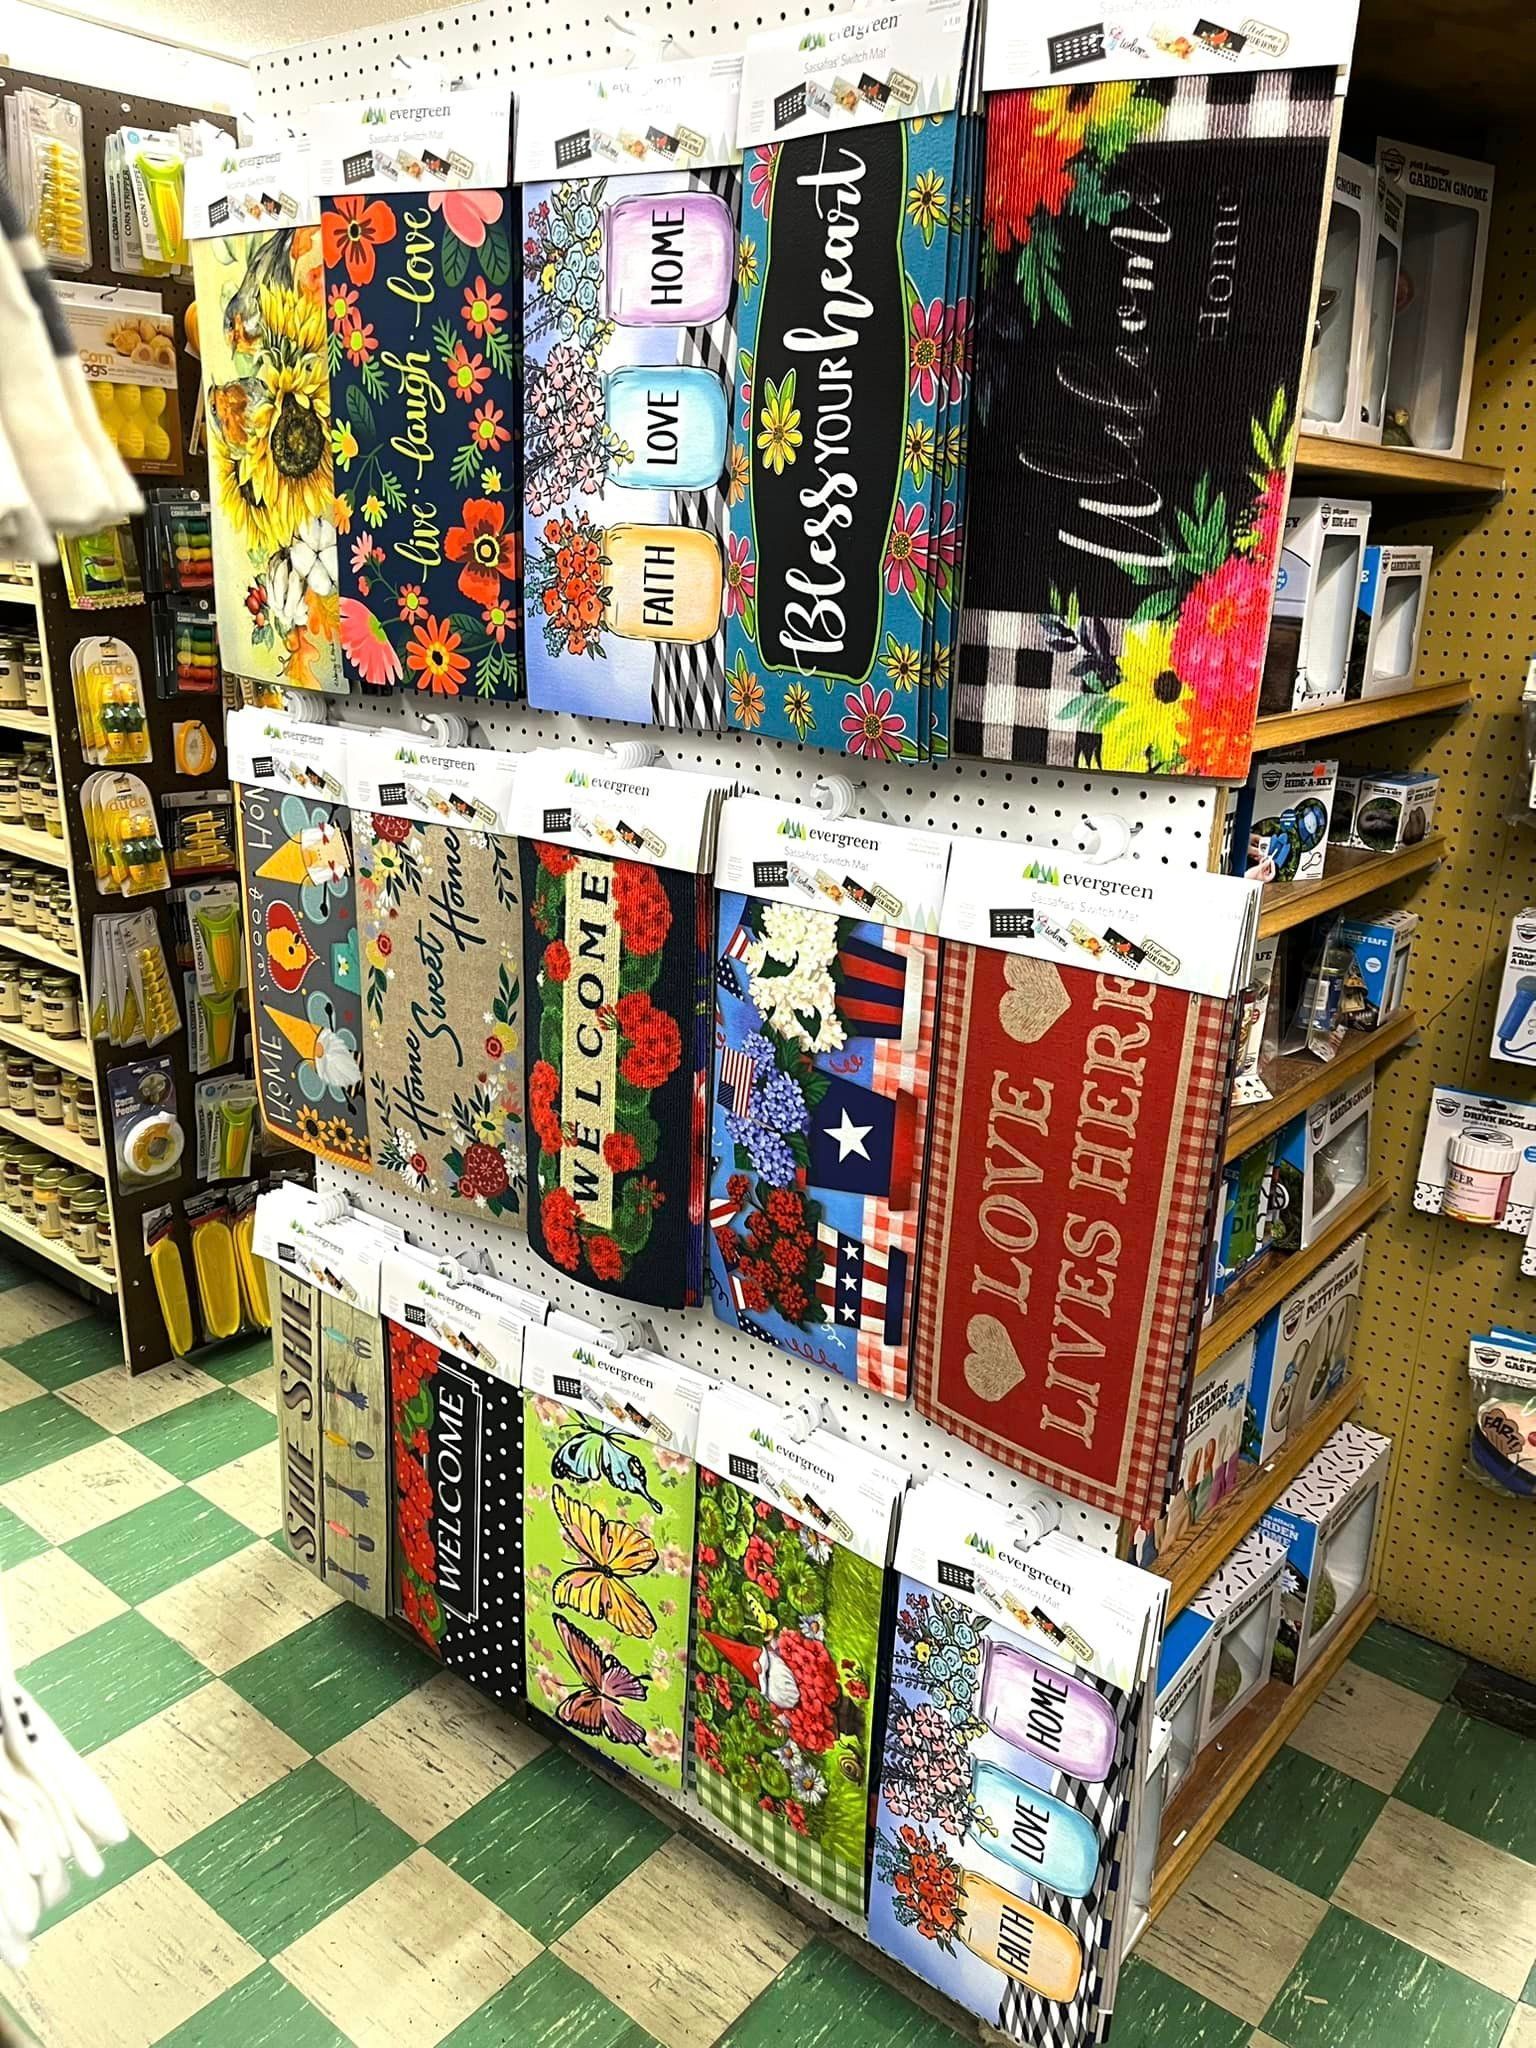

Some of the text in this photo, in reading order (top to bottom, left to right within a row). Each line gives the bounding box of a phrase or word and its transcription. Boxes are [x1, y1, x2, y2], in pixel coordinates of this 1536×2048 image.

[868, 46, 887, 60] Mat
[389, 105, 451, 122] evergreen
[239, 151, 281, 170] evergreen
[1335, 175, 1362, 200] GNOME
[1409, 171, 1488, 202] GARDEN GNOME
[650, 206, 686, 306] HOME
[79, 348, 115, 365] Corn
[82, 363, 108, 377] ogs
[381, 207, 447, 584] live laugh love
[779, 132, 874, 678] Bless YOUR heart
[646, 388, 680, 465] LOVE
[642, 544, 676, 627] FAITH
[89, 661, 135, 676] dude
[282, 731, 324, 746] evergreen
[419, 754, 475, 772] evergreen
[591, 777, 650, 797] evergreen
[1284, 777, 1334, 789] HIDE-A-KEY
[107, 797, 148, 813] dude
[809, 828, 879, 851] evergreen
[429, 827, 487, 952] Home
[1062, 872, 1154, 900] evergreen
[244, 785, 293, 1123] HOME sweet HOM
[1255, 950, 1273, 962] AFE
[411, 919, 463, 1068] Sweet
[573, 871, 610, 1204] WELCOME
[392, 1028, 446, 1141] Home
[1463, 1110, 1497, 1125] DRINK
[1464, 1104, 1508, 1117] prescription
[972, 1069, 1055, 1316] LOVE
[1040, 972, 1157, 1450] LIVES HERE
[305, 1230, 344, 1256] evergreen
[437, 1291, 481, 1321] evergreen
[597, 1360, 654, 1389] evergreen
[1504, 1360, 1526, 1373] GAS
[1196, 1379, 1229, 1416] HANDS
[1185, 1392, 1229, 1438] LECTION
[1483, 1415, 1521, 1452] FART!
[776, 1443, 835, 1483] evergreen
[437, 1385, 465, 1593] WELCOME
[1260, 1518, 1299, 1542] ARDEN
[998, 1551, 1072, 1596] evergreen
[1026, 1668, 1070, 1754] HOME
[1010, 1794, 1051, 1865] LOVE
[997, 1903, 1035, 1976] FAITH
